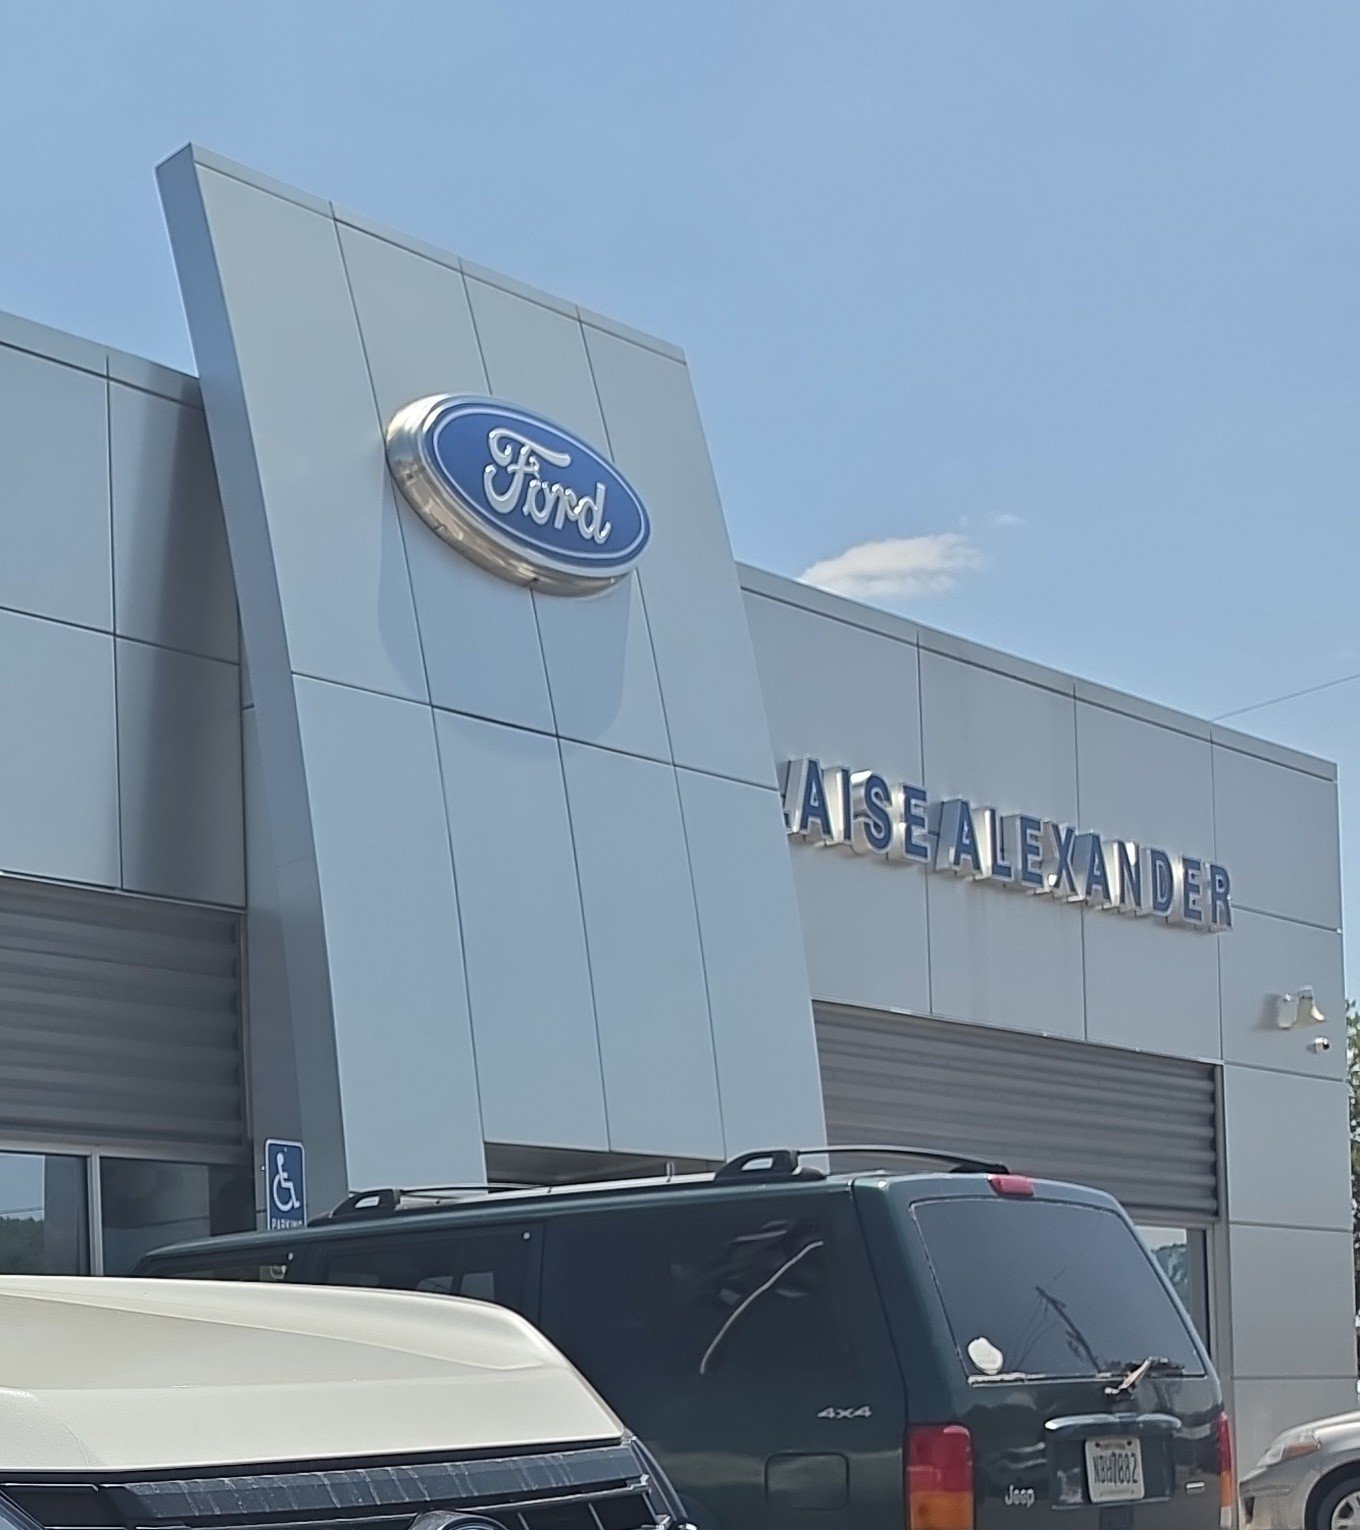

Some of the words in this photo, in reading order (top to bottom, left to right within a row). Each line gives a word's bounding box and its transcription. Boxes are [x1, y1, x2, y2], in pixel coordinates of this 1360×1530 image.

[483, 427, 612, 545] Ford
[782, 757, 931, 864] AISE
[942, 797, 1233, 931] ALEXANDER
[1004, 1484, 1035, 1508] Jeep
